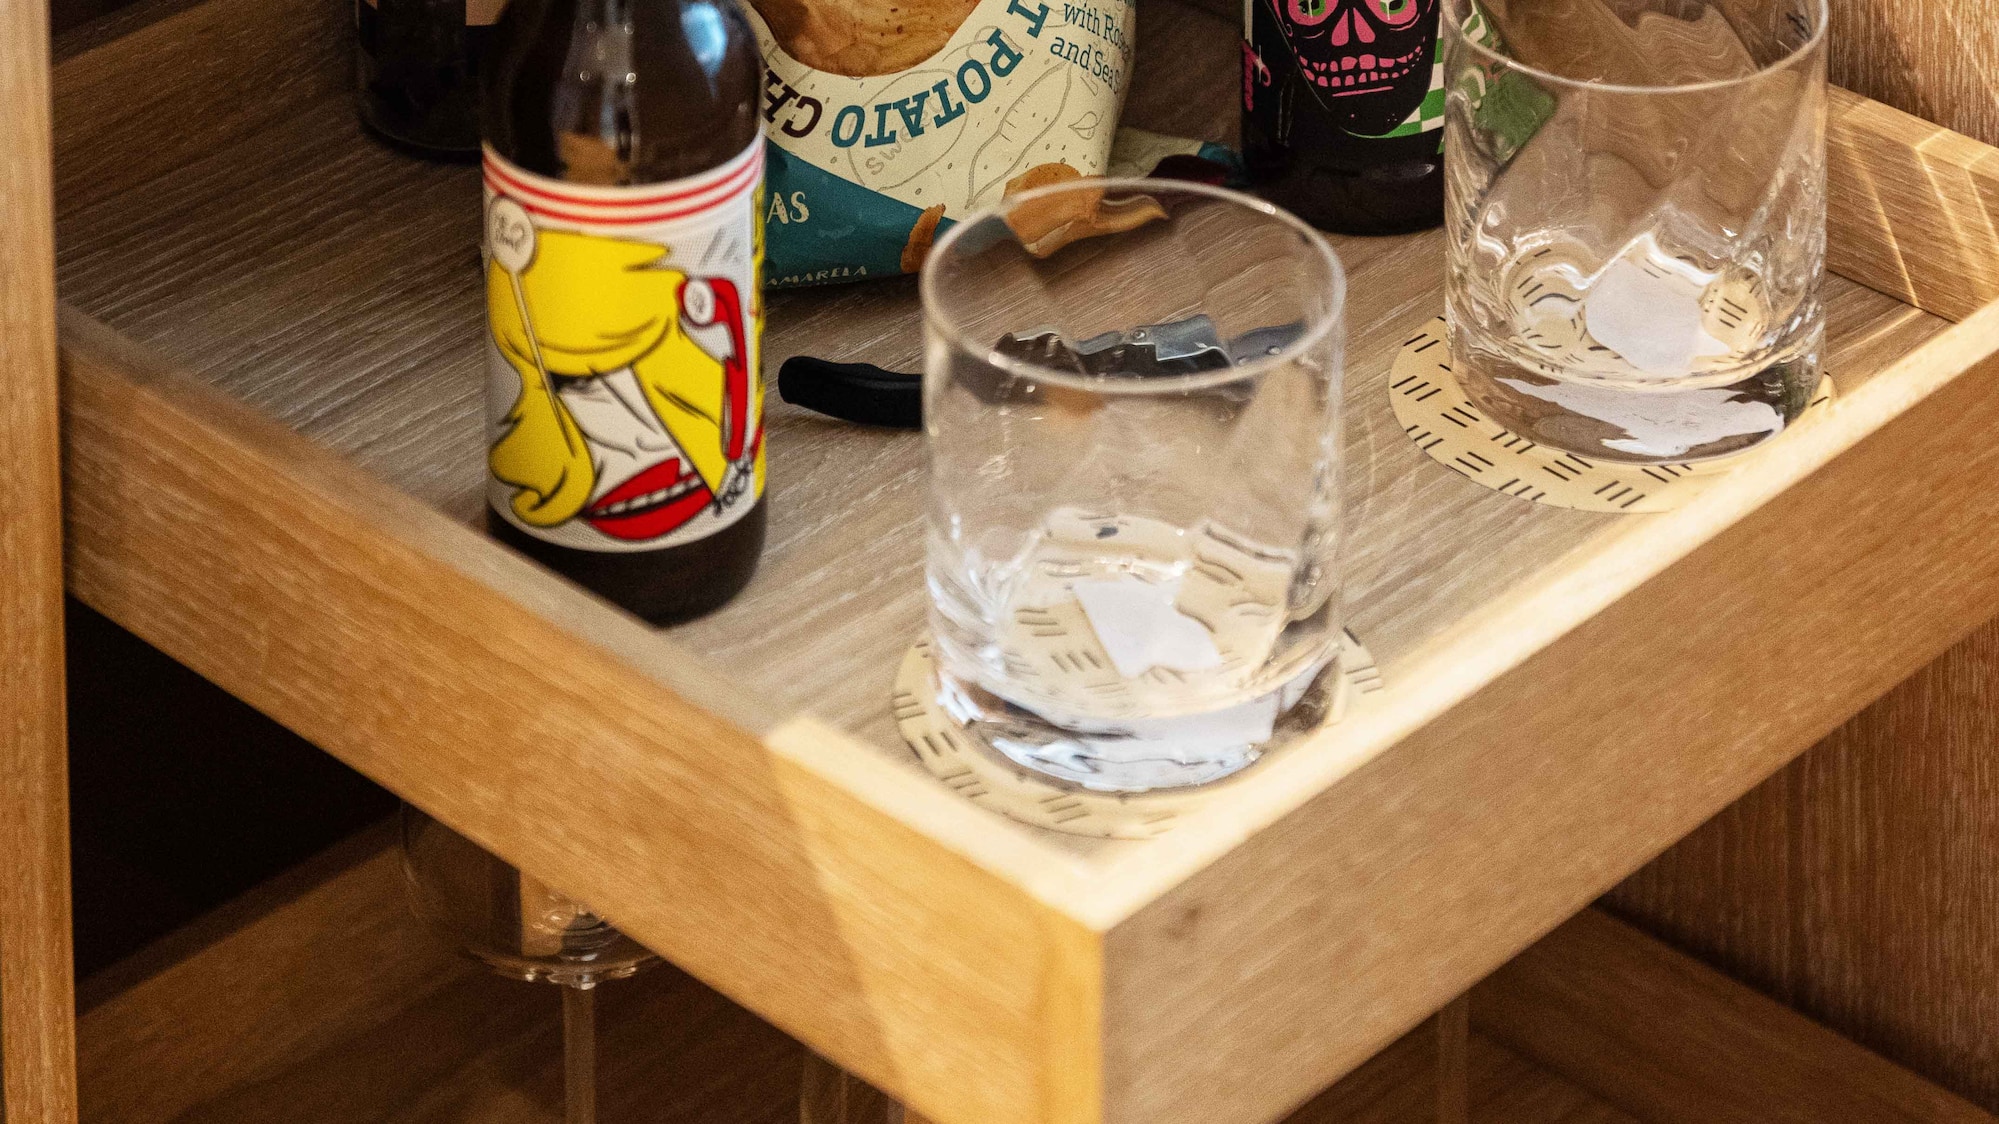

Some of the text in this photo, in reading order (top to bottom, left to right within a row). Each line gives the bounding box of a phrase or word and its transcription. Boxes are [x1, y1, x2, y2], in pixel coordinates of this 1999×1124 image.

[1064, 3, 1101, 36] with
[1050, 36, 1092, 70] and
[831, 28, 1024, 148] POTATO
